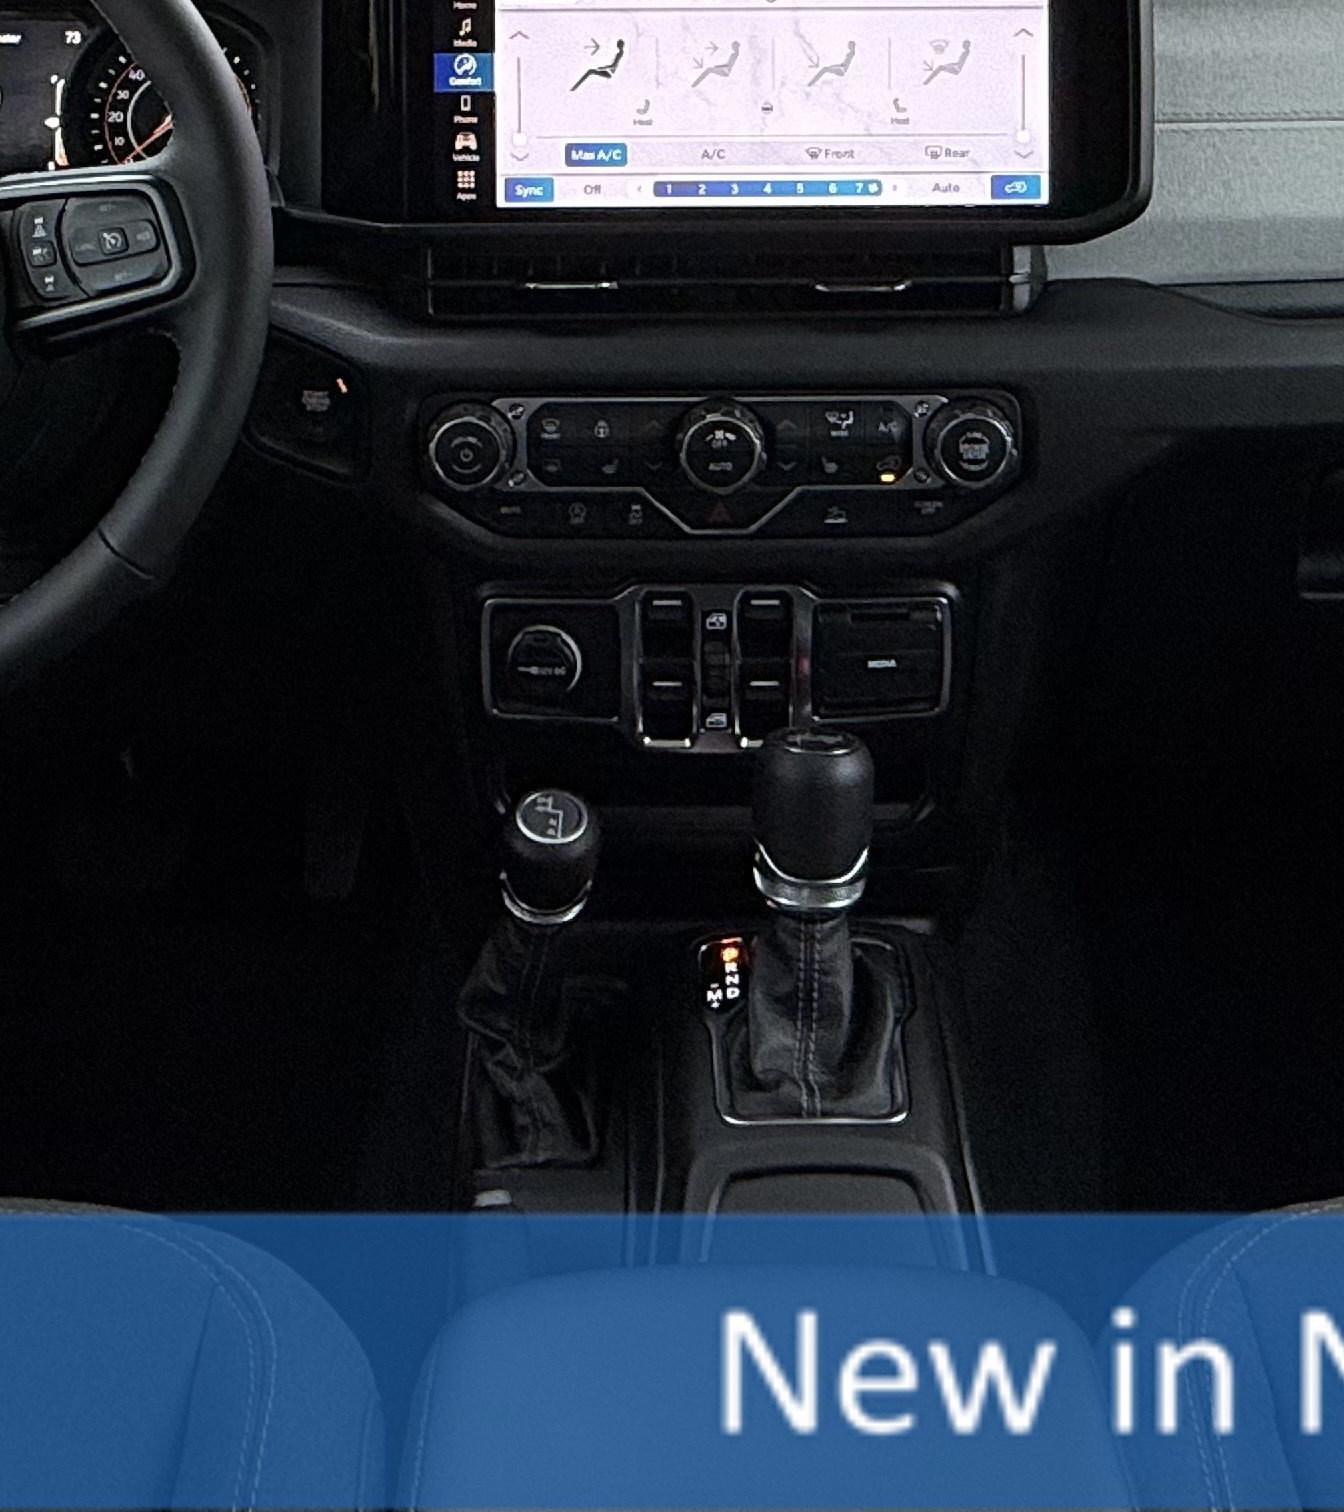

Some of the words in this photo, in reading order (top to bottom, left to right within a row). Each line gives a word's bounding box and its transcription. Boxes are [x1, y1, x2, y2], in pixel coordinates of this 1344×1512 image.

[64, 31, 82, 45] 73
[116, 89, 130, 100] 30
[108, 111, 124, 123] 20
[571, 149, 596, 160] Max
[597, 149, 622, 161] A/C
[701, 149, 726, 161] A/C
[825, 148, 855, 159] Front
[944, 148, 970, 159] Rear
[514, 184, 544, 198] Sync
[583, 184, 602, 195] Off
[698, 184, 707, 195] 2
[730, 183, 739, 195] 3
[762, 182, 772, 194] 4
[855, 183, 864, 194] 7
[932, 182, 960, 194] Auto
[726, 987, 740, 999] D
